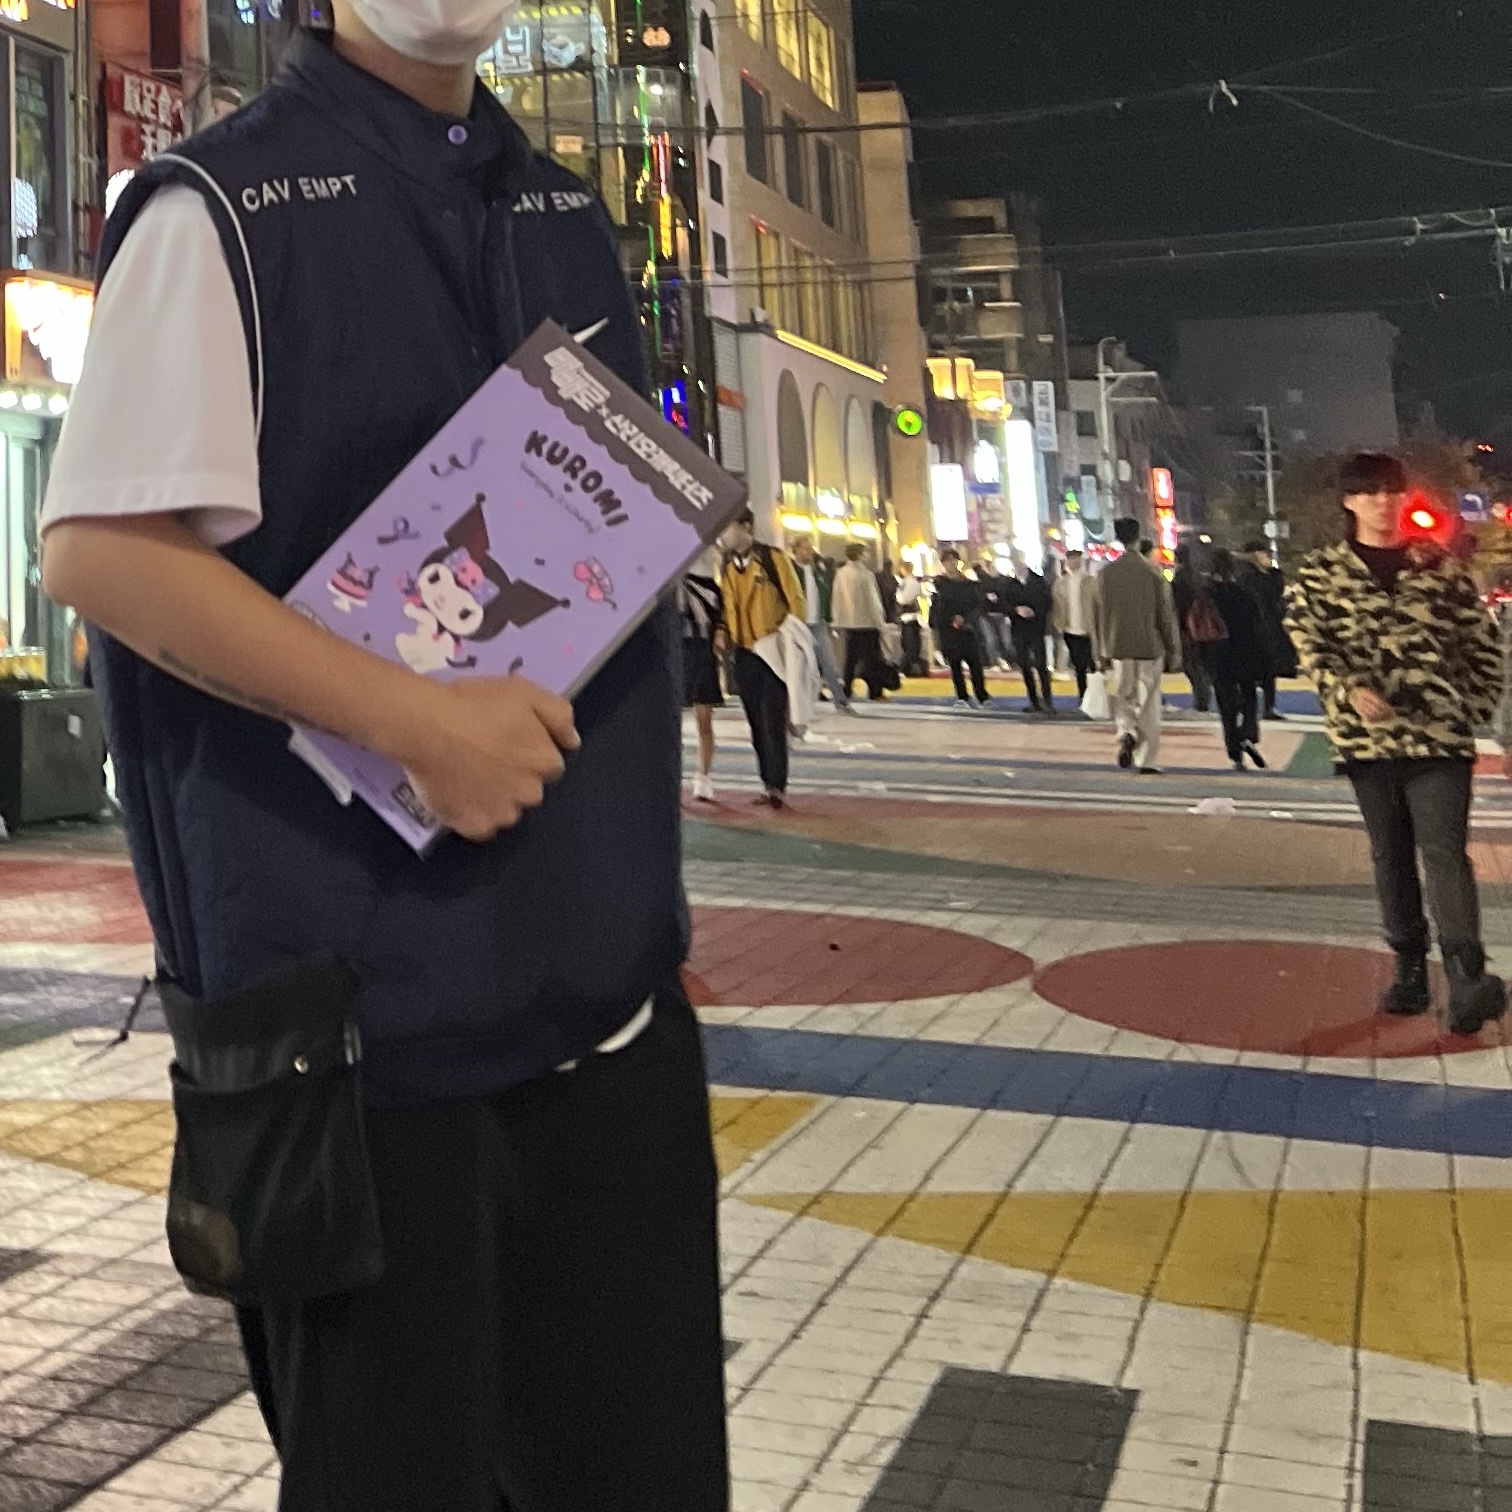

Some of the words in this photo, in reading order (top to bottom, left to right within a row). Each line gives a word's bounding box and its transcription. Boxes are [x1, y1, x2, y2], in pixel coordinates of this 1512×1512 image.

[242, 178, 291, 213] CAV
[298, 174, 358, 202] EMPT
[524, 430, 630, 528] KUROMI
